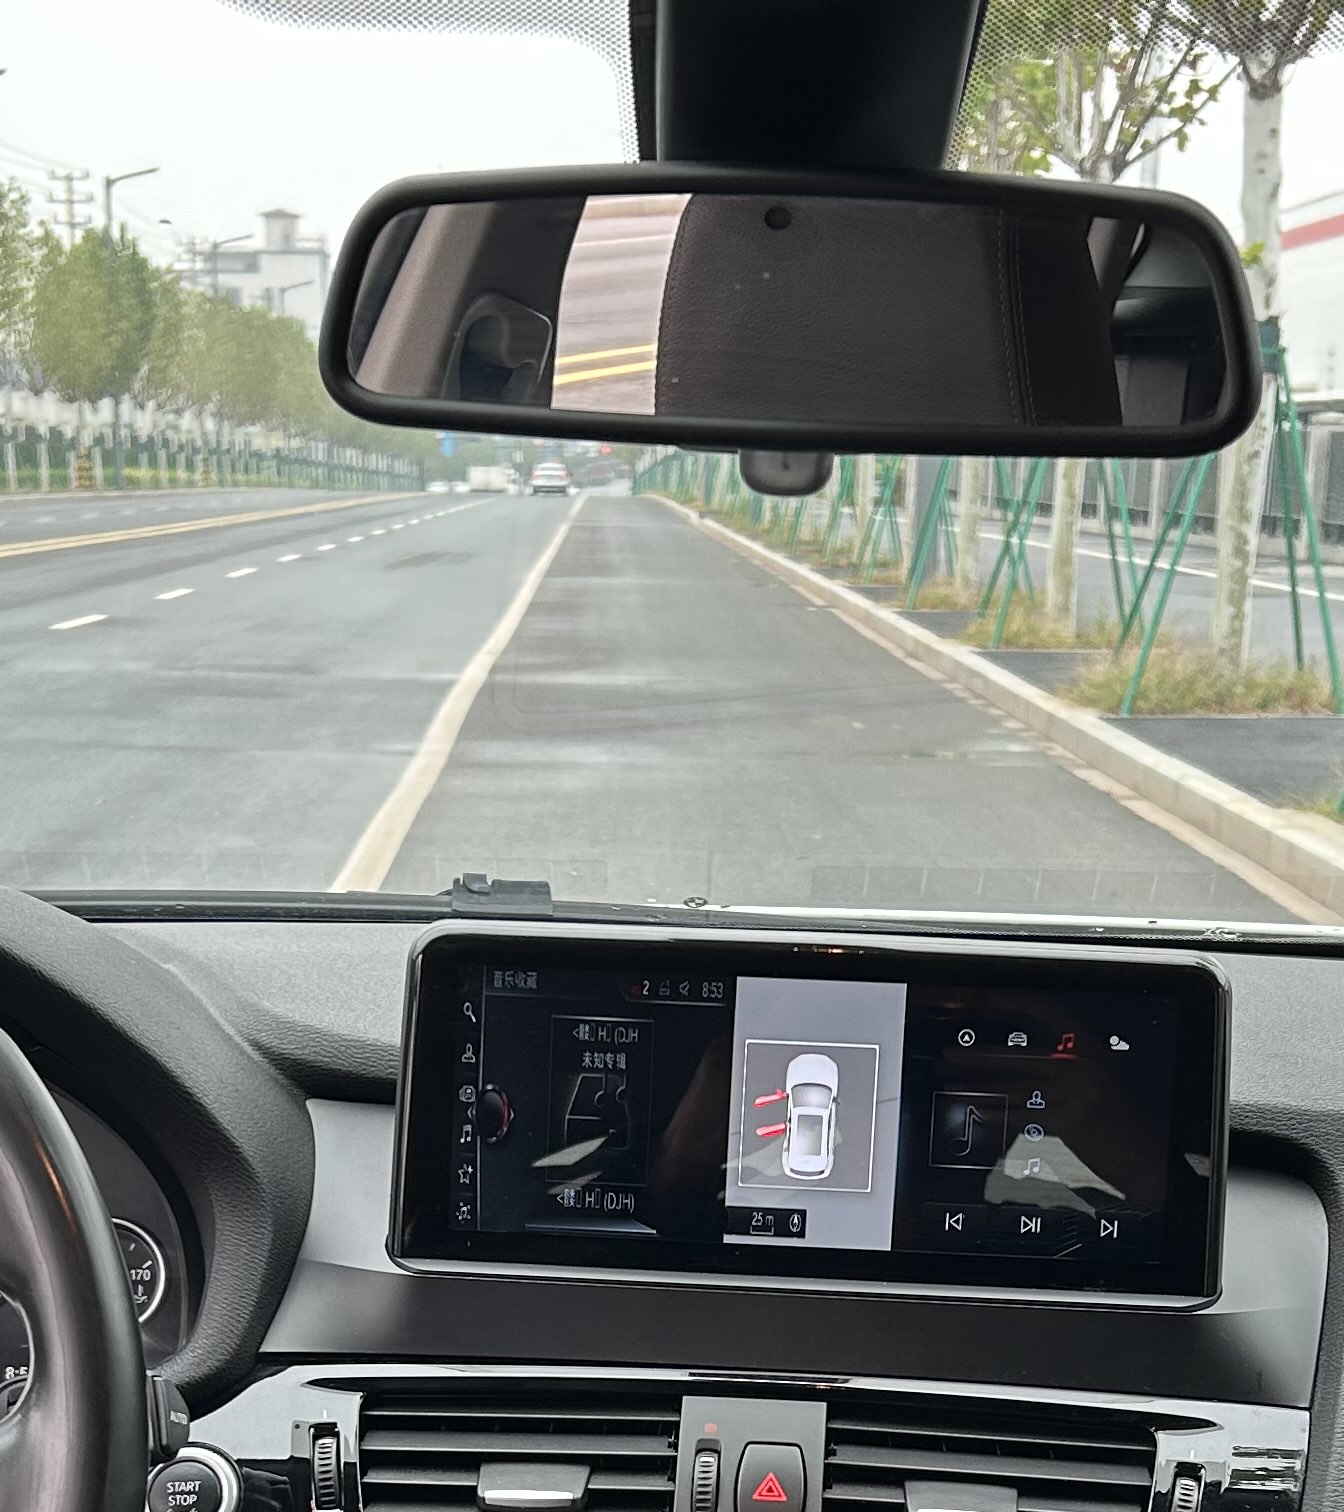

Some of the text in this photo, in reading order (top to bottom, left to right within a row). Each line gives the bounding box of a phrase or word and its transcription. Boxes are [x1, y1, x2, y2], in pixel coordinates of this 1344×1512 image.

[493, 970, 538, 990] 音乐收藏
[642, 980, 650, 995] 2
[702, 982, 723, 998] 8:53
[581, 1051, 626, 1070] 未知专辑
[752, 1212, 774, 1226] 25 m
[130, 1268, 151, 1281] 170
[166, 1481, 201, 1493] START
[168, 1494, 197, 1506] STOP
